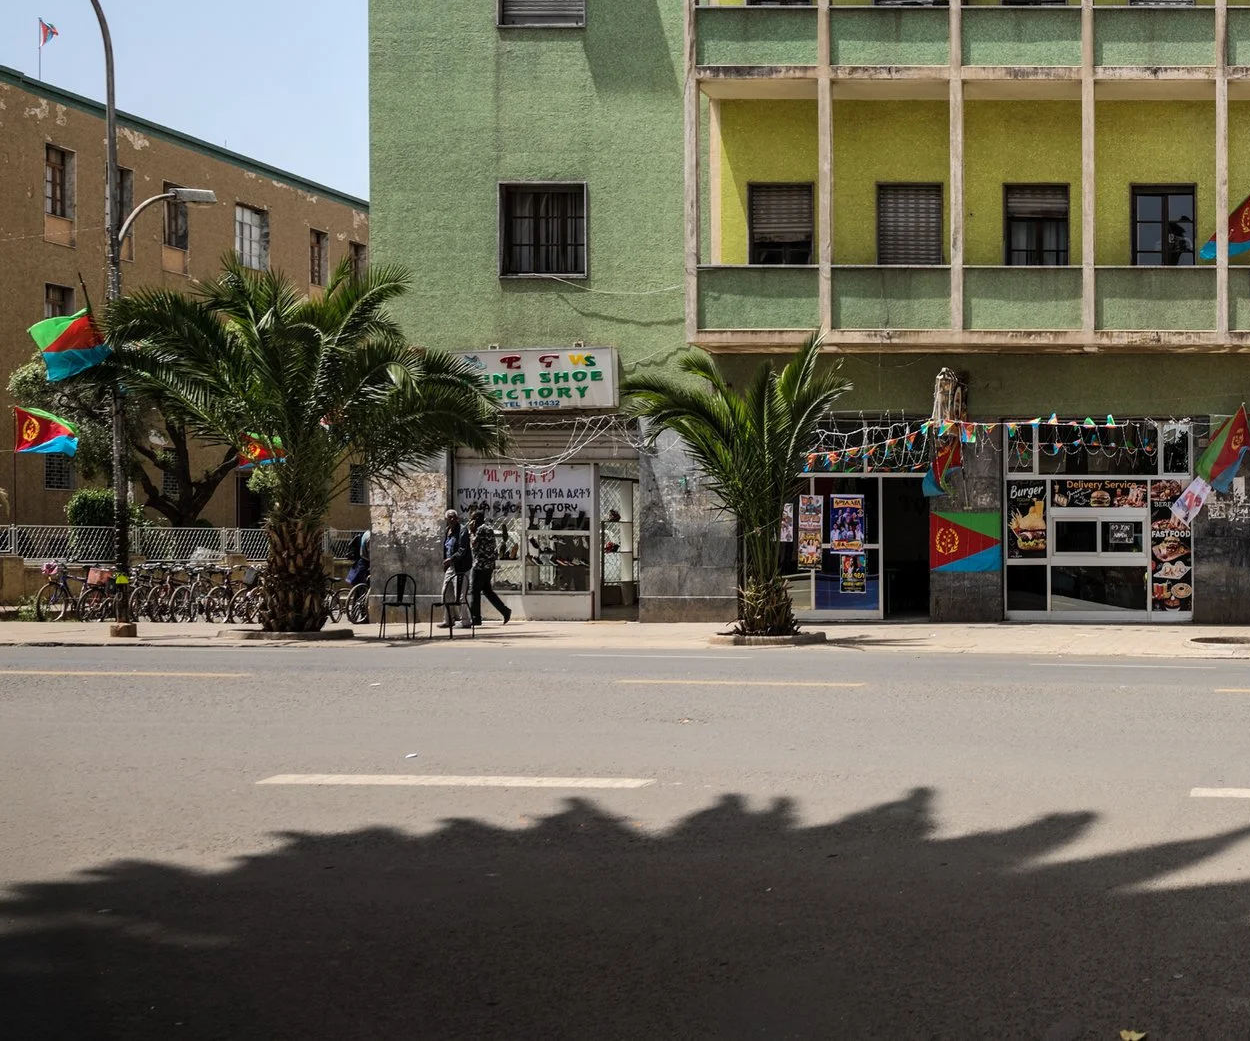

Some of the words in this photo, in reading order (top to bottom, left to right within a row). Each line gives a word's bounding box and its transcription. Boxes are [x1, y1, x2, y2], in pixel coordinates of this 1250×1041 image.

[539, 370, 604, 385] SHOE
[488, 385, 589, 400] ACTORY
[1010, 485, 1044, 499] Burger
[1066, 480, 1103, 490] Delivery
[1104, 480, 1137, 489] Service
[1152, 530, 1170, 538] FAST
[1170, 530, 1191, 538] FOOD
